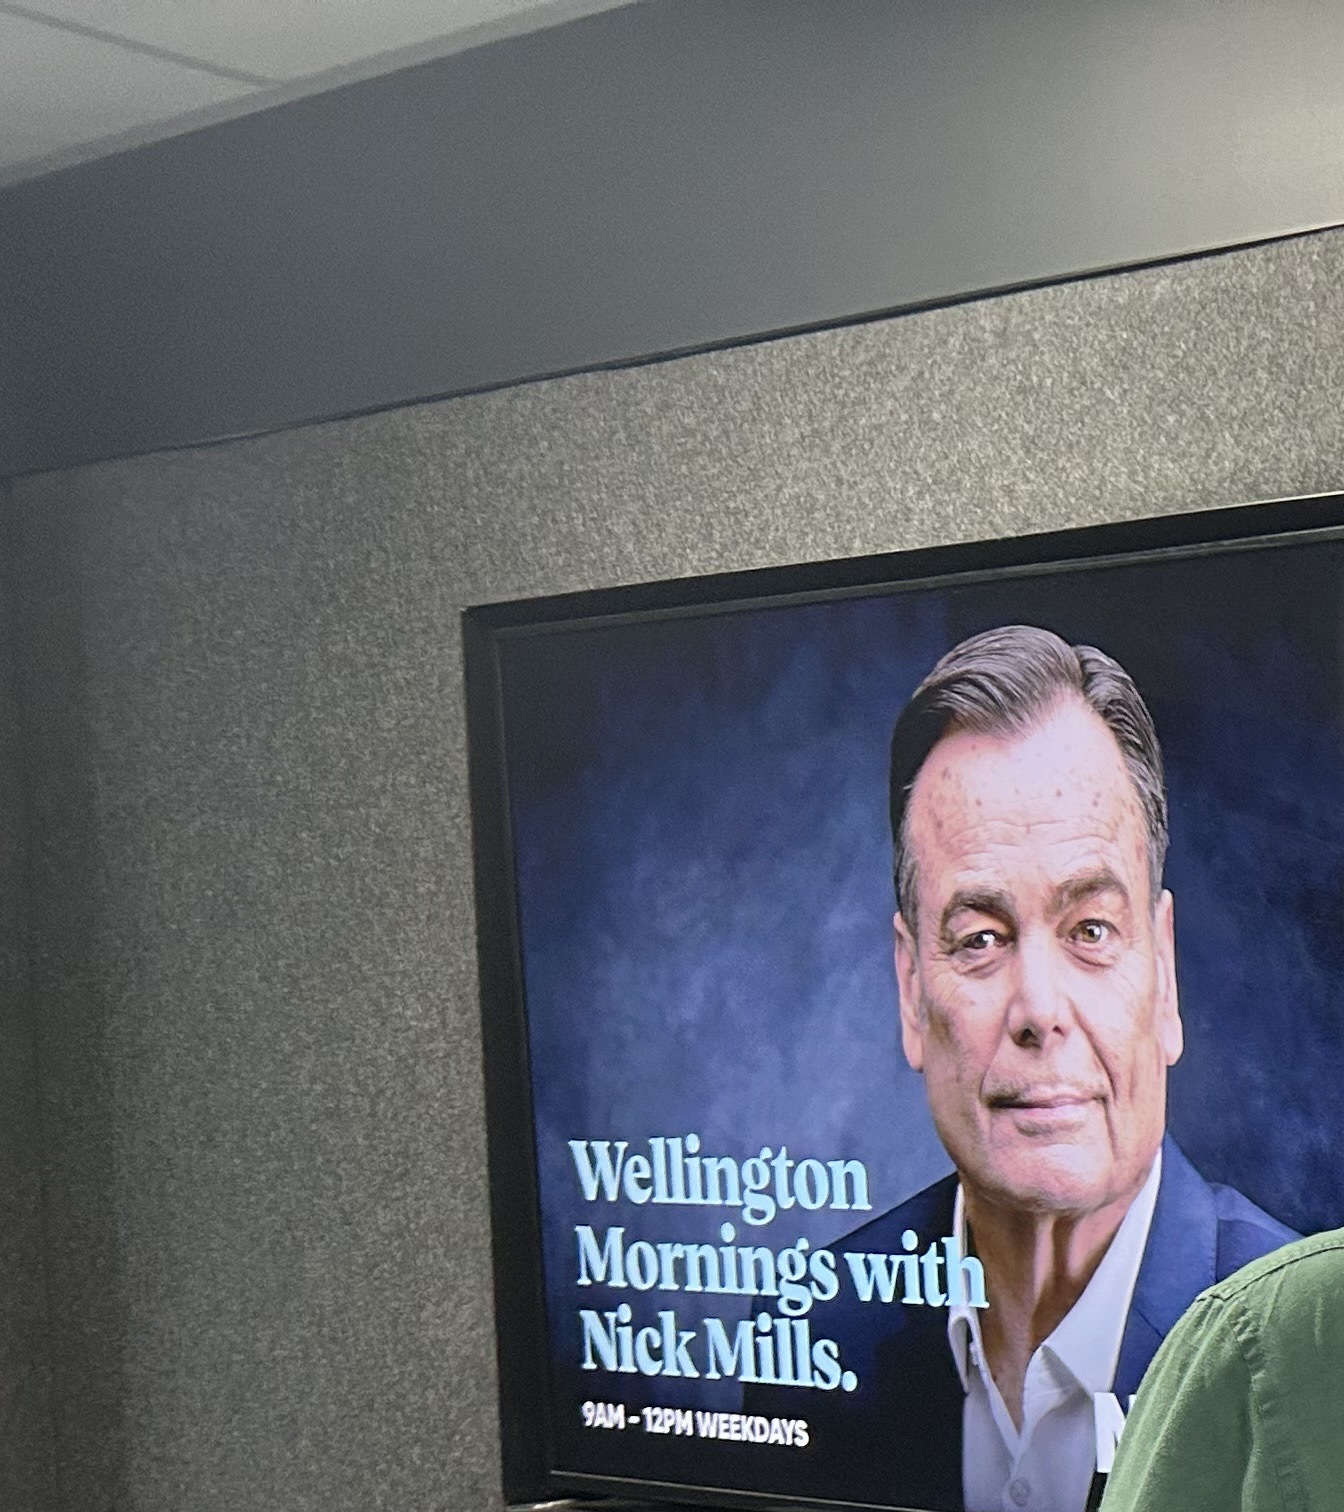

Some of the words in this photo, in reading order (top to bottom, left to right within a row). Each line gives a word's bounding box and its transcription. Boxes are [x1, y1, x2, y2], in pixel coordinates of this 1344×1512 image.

[567, 1133, 872, 1226] Wellington
[574, 1222, 839, 1317] Mornings
[843, 1229, 990, 1309] with
[579, 1303, 699, 1378] Nick
[703, 1312, 858, 1392] Mills.
[581, 1400, 626, 1430] 9AM
[641, 1406, 694, 1436] 12PM
[694, 1410, 810, 1447] WEEKDAYS
